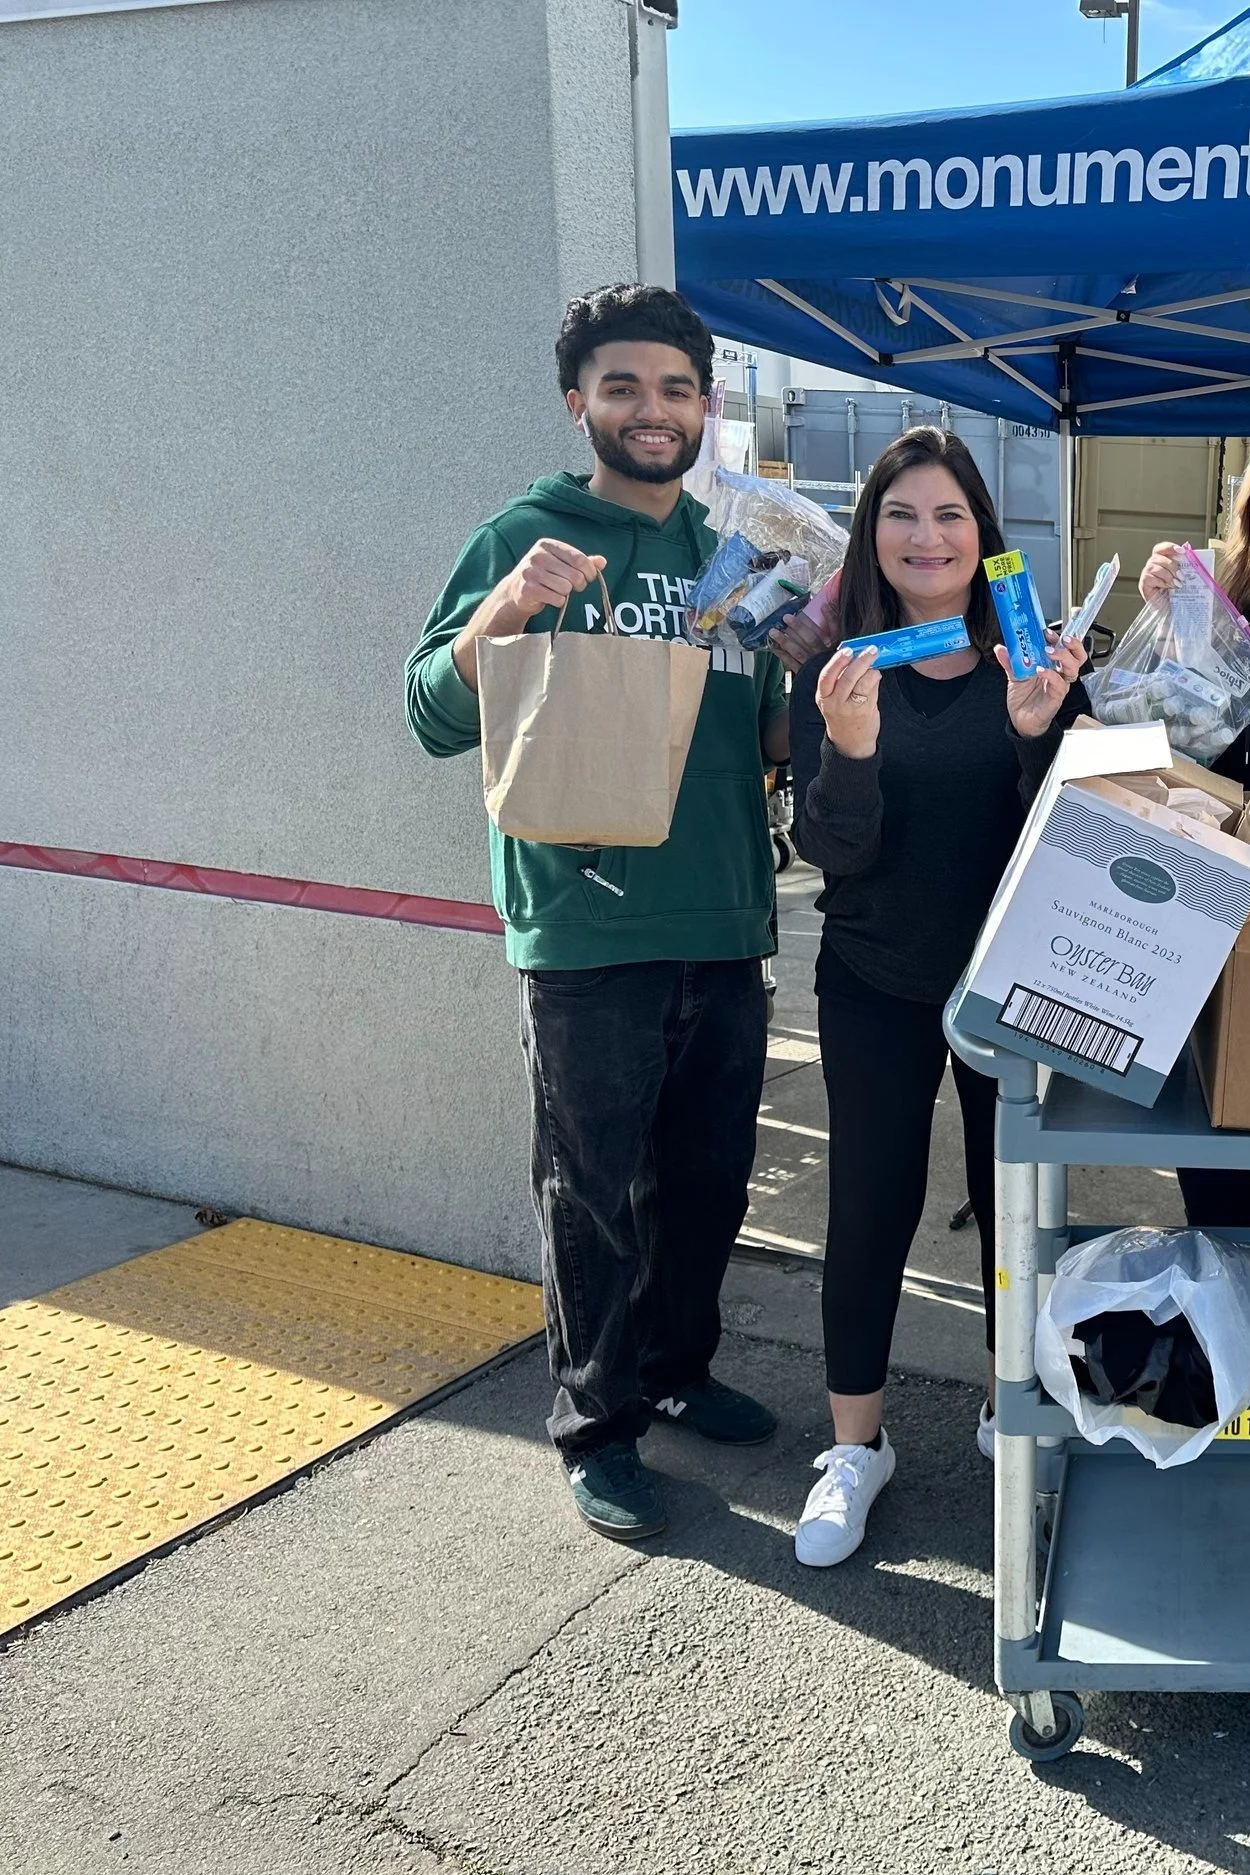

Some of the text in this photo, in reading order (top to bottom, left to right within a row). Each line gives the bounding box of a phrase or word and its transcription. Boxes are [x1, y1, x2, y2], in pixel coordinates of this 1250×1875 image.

[585, 602, 685, 635] NORT
[1015, 628, 1032, 668] Crest
[1051, 899, 1182, 965] Sauvignon Blanc 2023
[1089, 900, 1158, 936] MARLBOROUGH
[1050, 935, 1157, 997] Oyster Bay
[1050, 961, 1137, 1004] NEW ZEALAND
[1033, 979, 1041, 987] 12
[1046, 984, 1065, 998] 750ml
[1064, 992, 1084, 1005] Bottles
[1084, 1000, 1100, 1013] White
[1101, 1008, 1115, 1019] Wine
